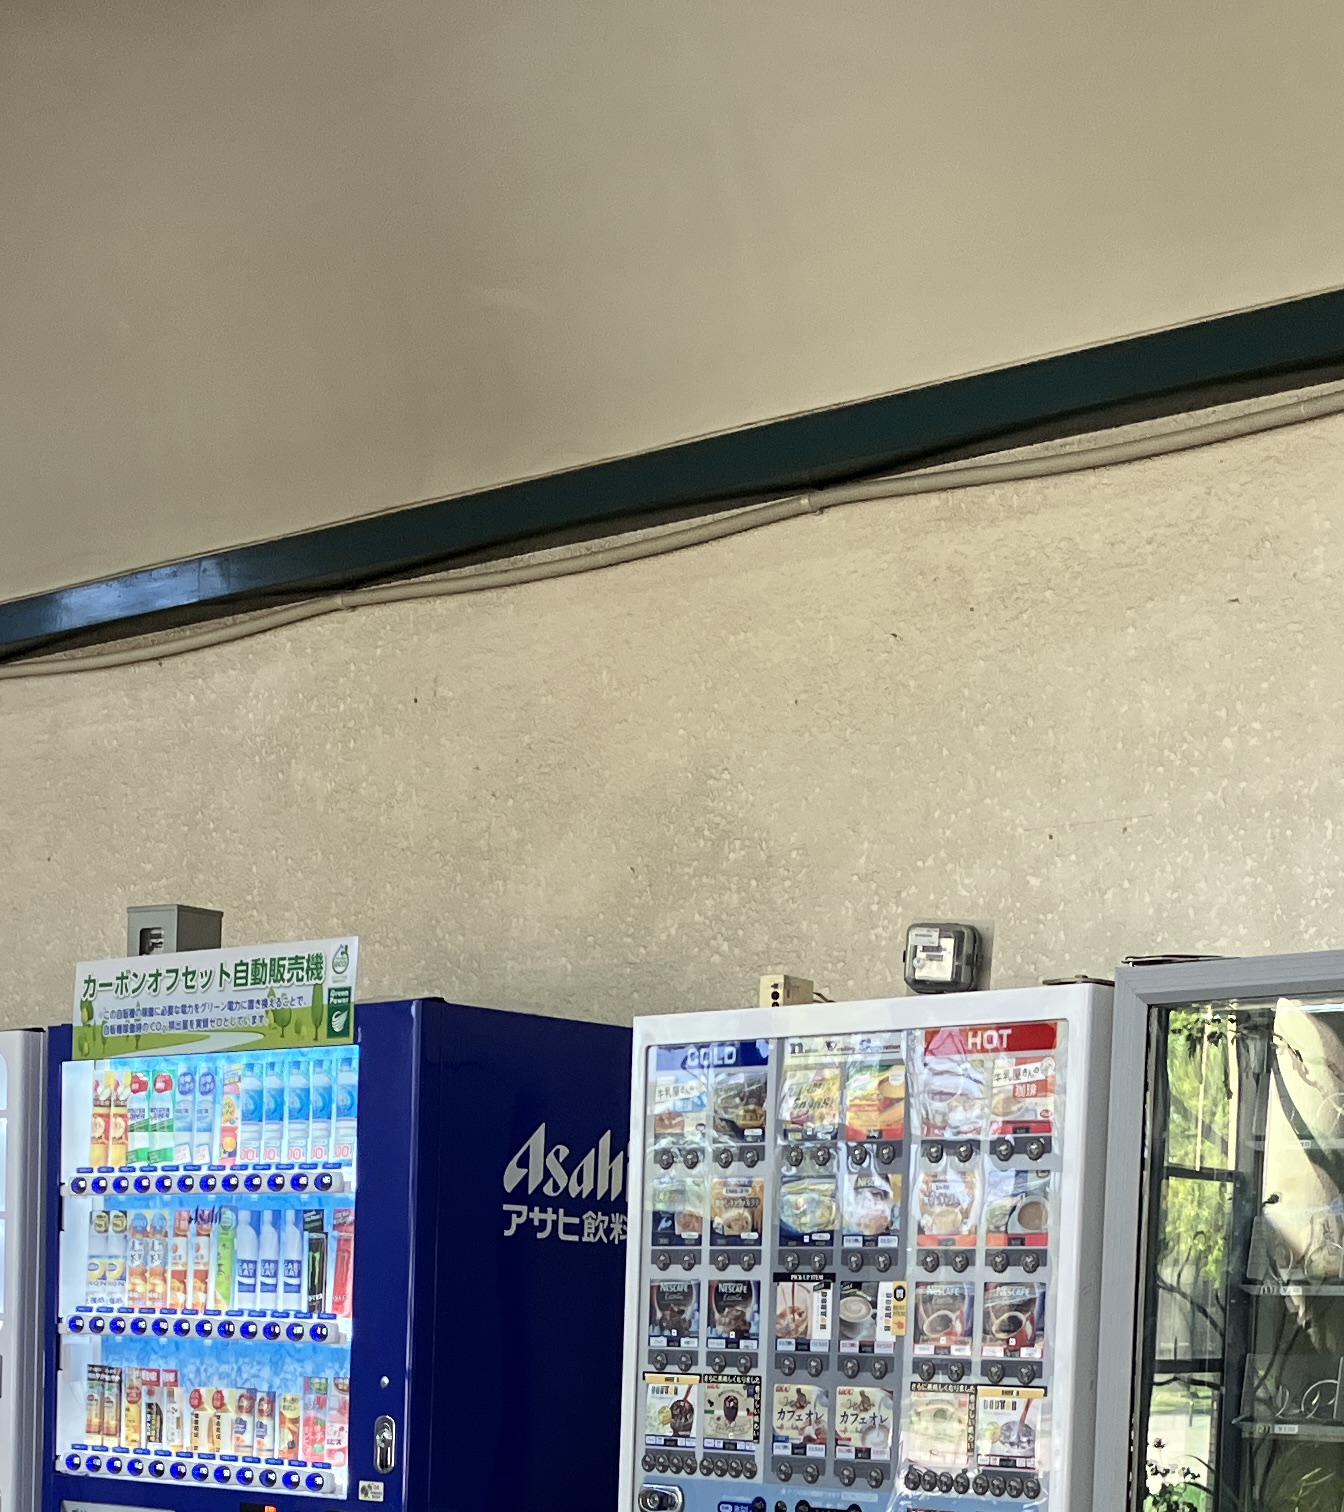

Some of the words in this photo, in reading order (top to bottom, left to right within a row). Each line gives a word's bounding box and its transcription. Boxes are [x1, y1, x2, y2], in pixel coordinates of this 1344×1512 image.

[82, 953, 325, 998] カーボンオフセット自動販売機
[968, 1029, 1012, 1050] HOT
[687, 1046, 736, 1066] COLD
[503, 1122, 629, 1202] Asah
[502, 1204, 627, 1245] アサヒ飲料
[777, 1407, 824, 1422] カフェオレ
[840, 1411, 888, 1426] カフェオレ
